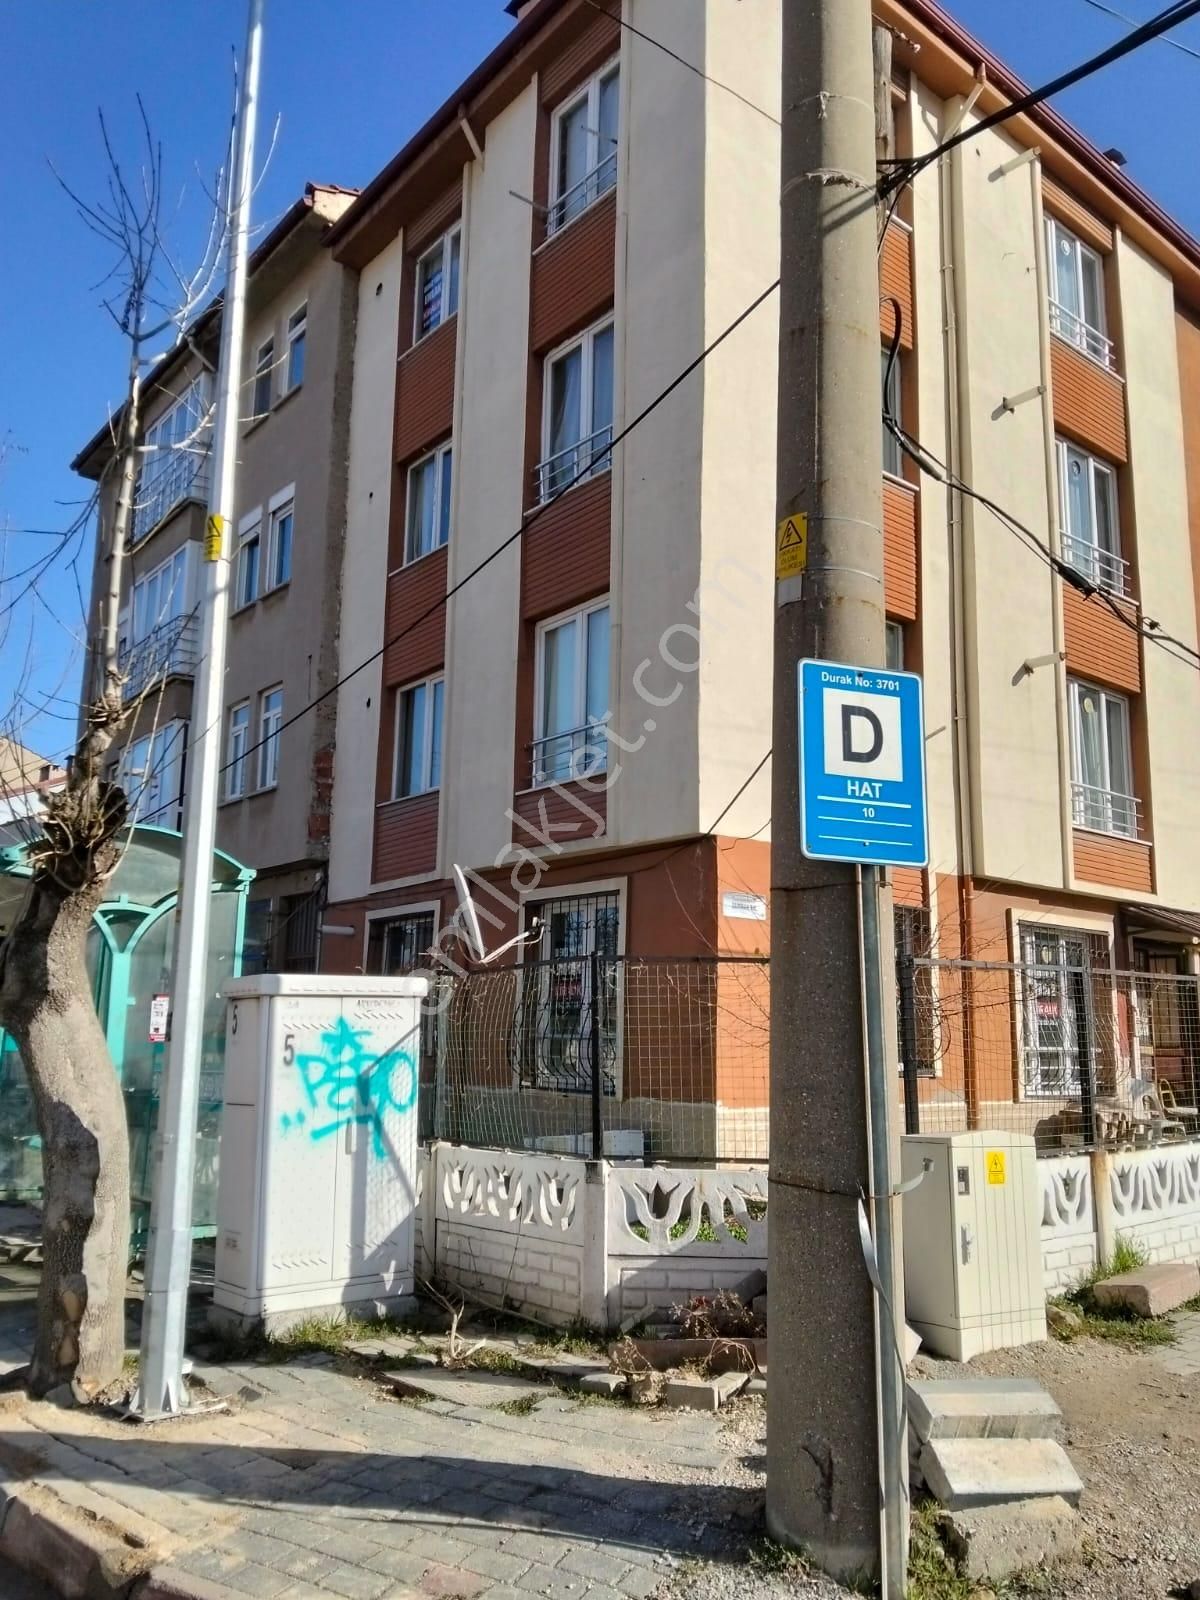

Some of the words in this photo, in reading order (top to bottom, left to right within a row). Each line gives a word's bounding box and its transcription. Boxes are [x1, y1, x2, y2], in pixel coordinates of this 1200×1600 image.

[821, 671, 853, 686] Durak
[855, 674, 873, 688] No:
[876, 679, 900, 691] 3701
[841, 703, 884, 763] D
[847, 779, 883, 799] HAT
[862, 807, 875, 818] 10
[283, 1034, 295, 1067] 5
